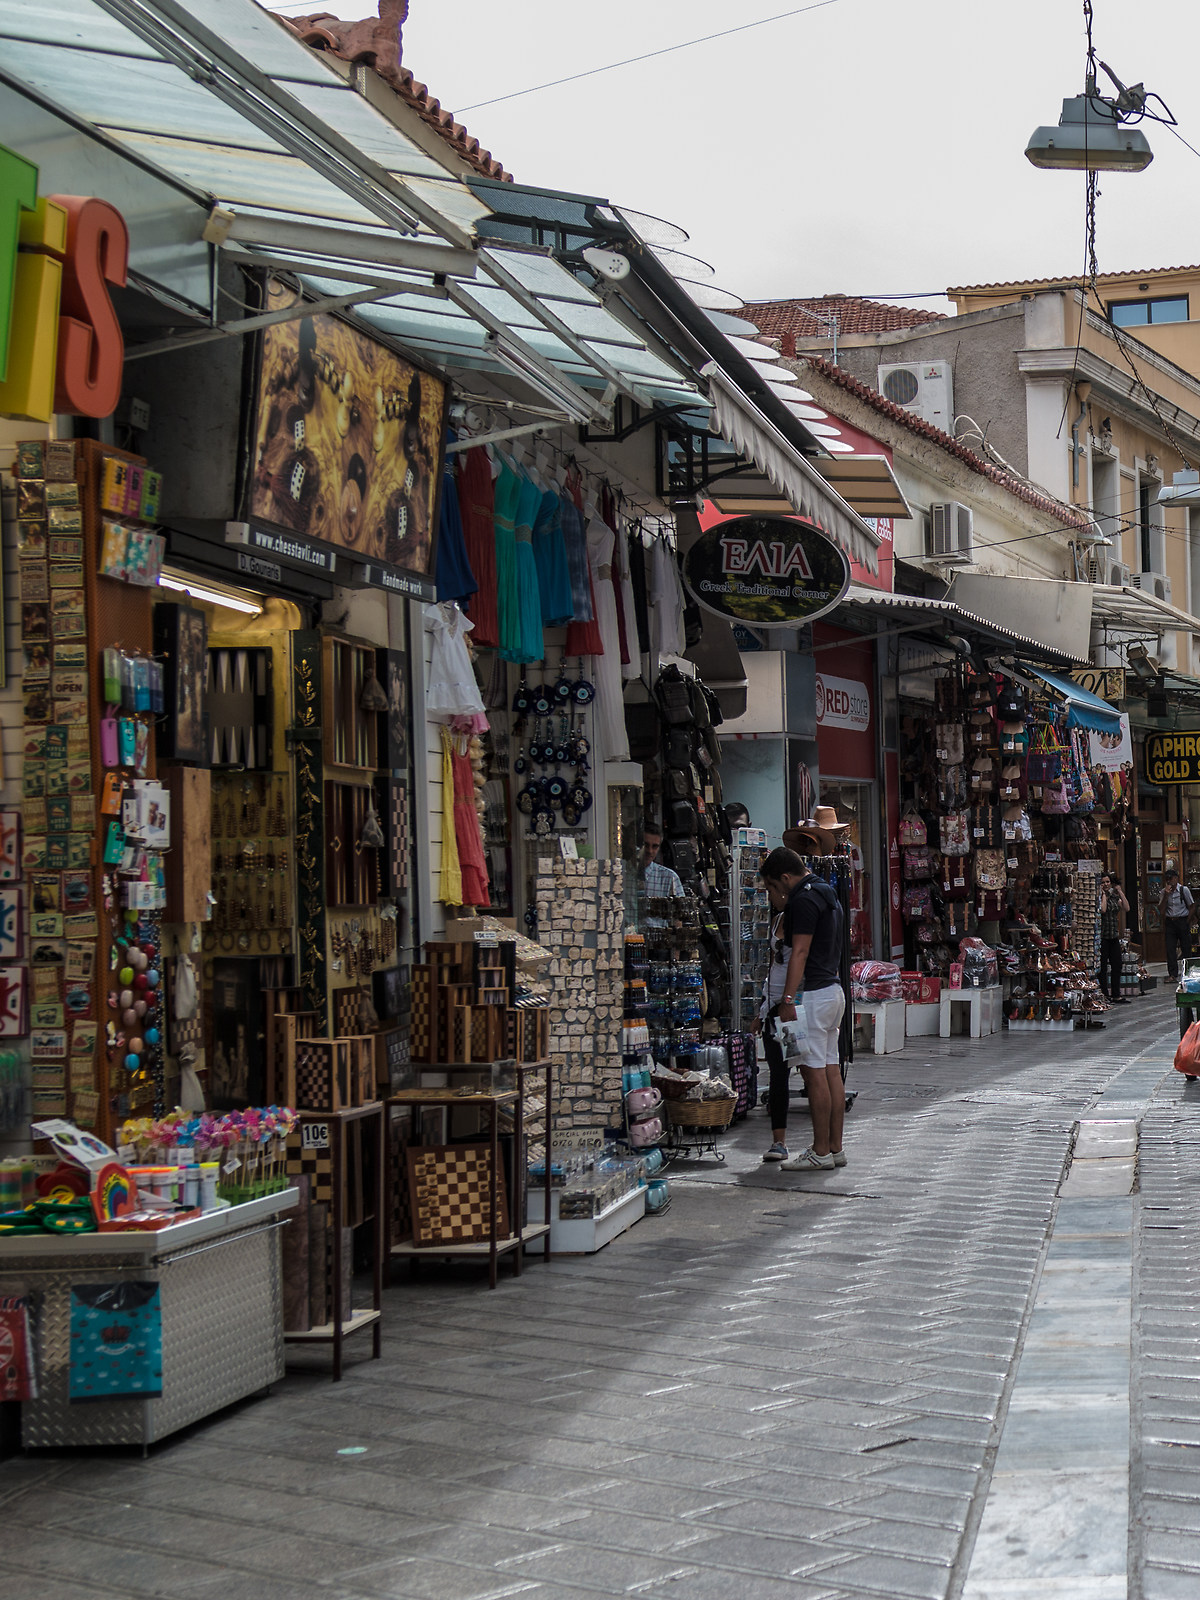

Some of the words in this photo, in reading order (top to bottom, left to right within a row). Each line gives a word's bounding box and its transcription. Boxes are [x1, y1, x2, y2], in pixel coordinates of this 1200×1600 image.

[255, 531, 326, 567] www.chesstavli.com
[720, 538, 814, 580] ΕΛΙΑ
[409, 582, 423, 596] work
[700, 579, 732, 593] Greek
[734, 582, 791, 597] Traditional
[792, 586, 830, 600] Corner
[826, 688, 849, 715] RED
[850, 692, 868, 715] store
[1153, 760, 1190, 779] GOLD
[304, 1125, 328, 1141] 10€
